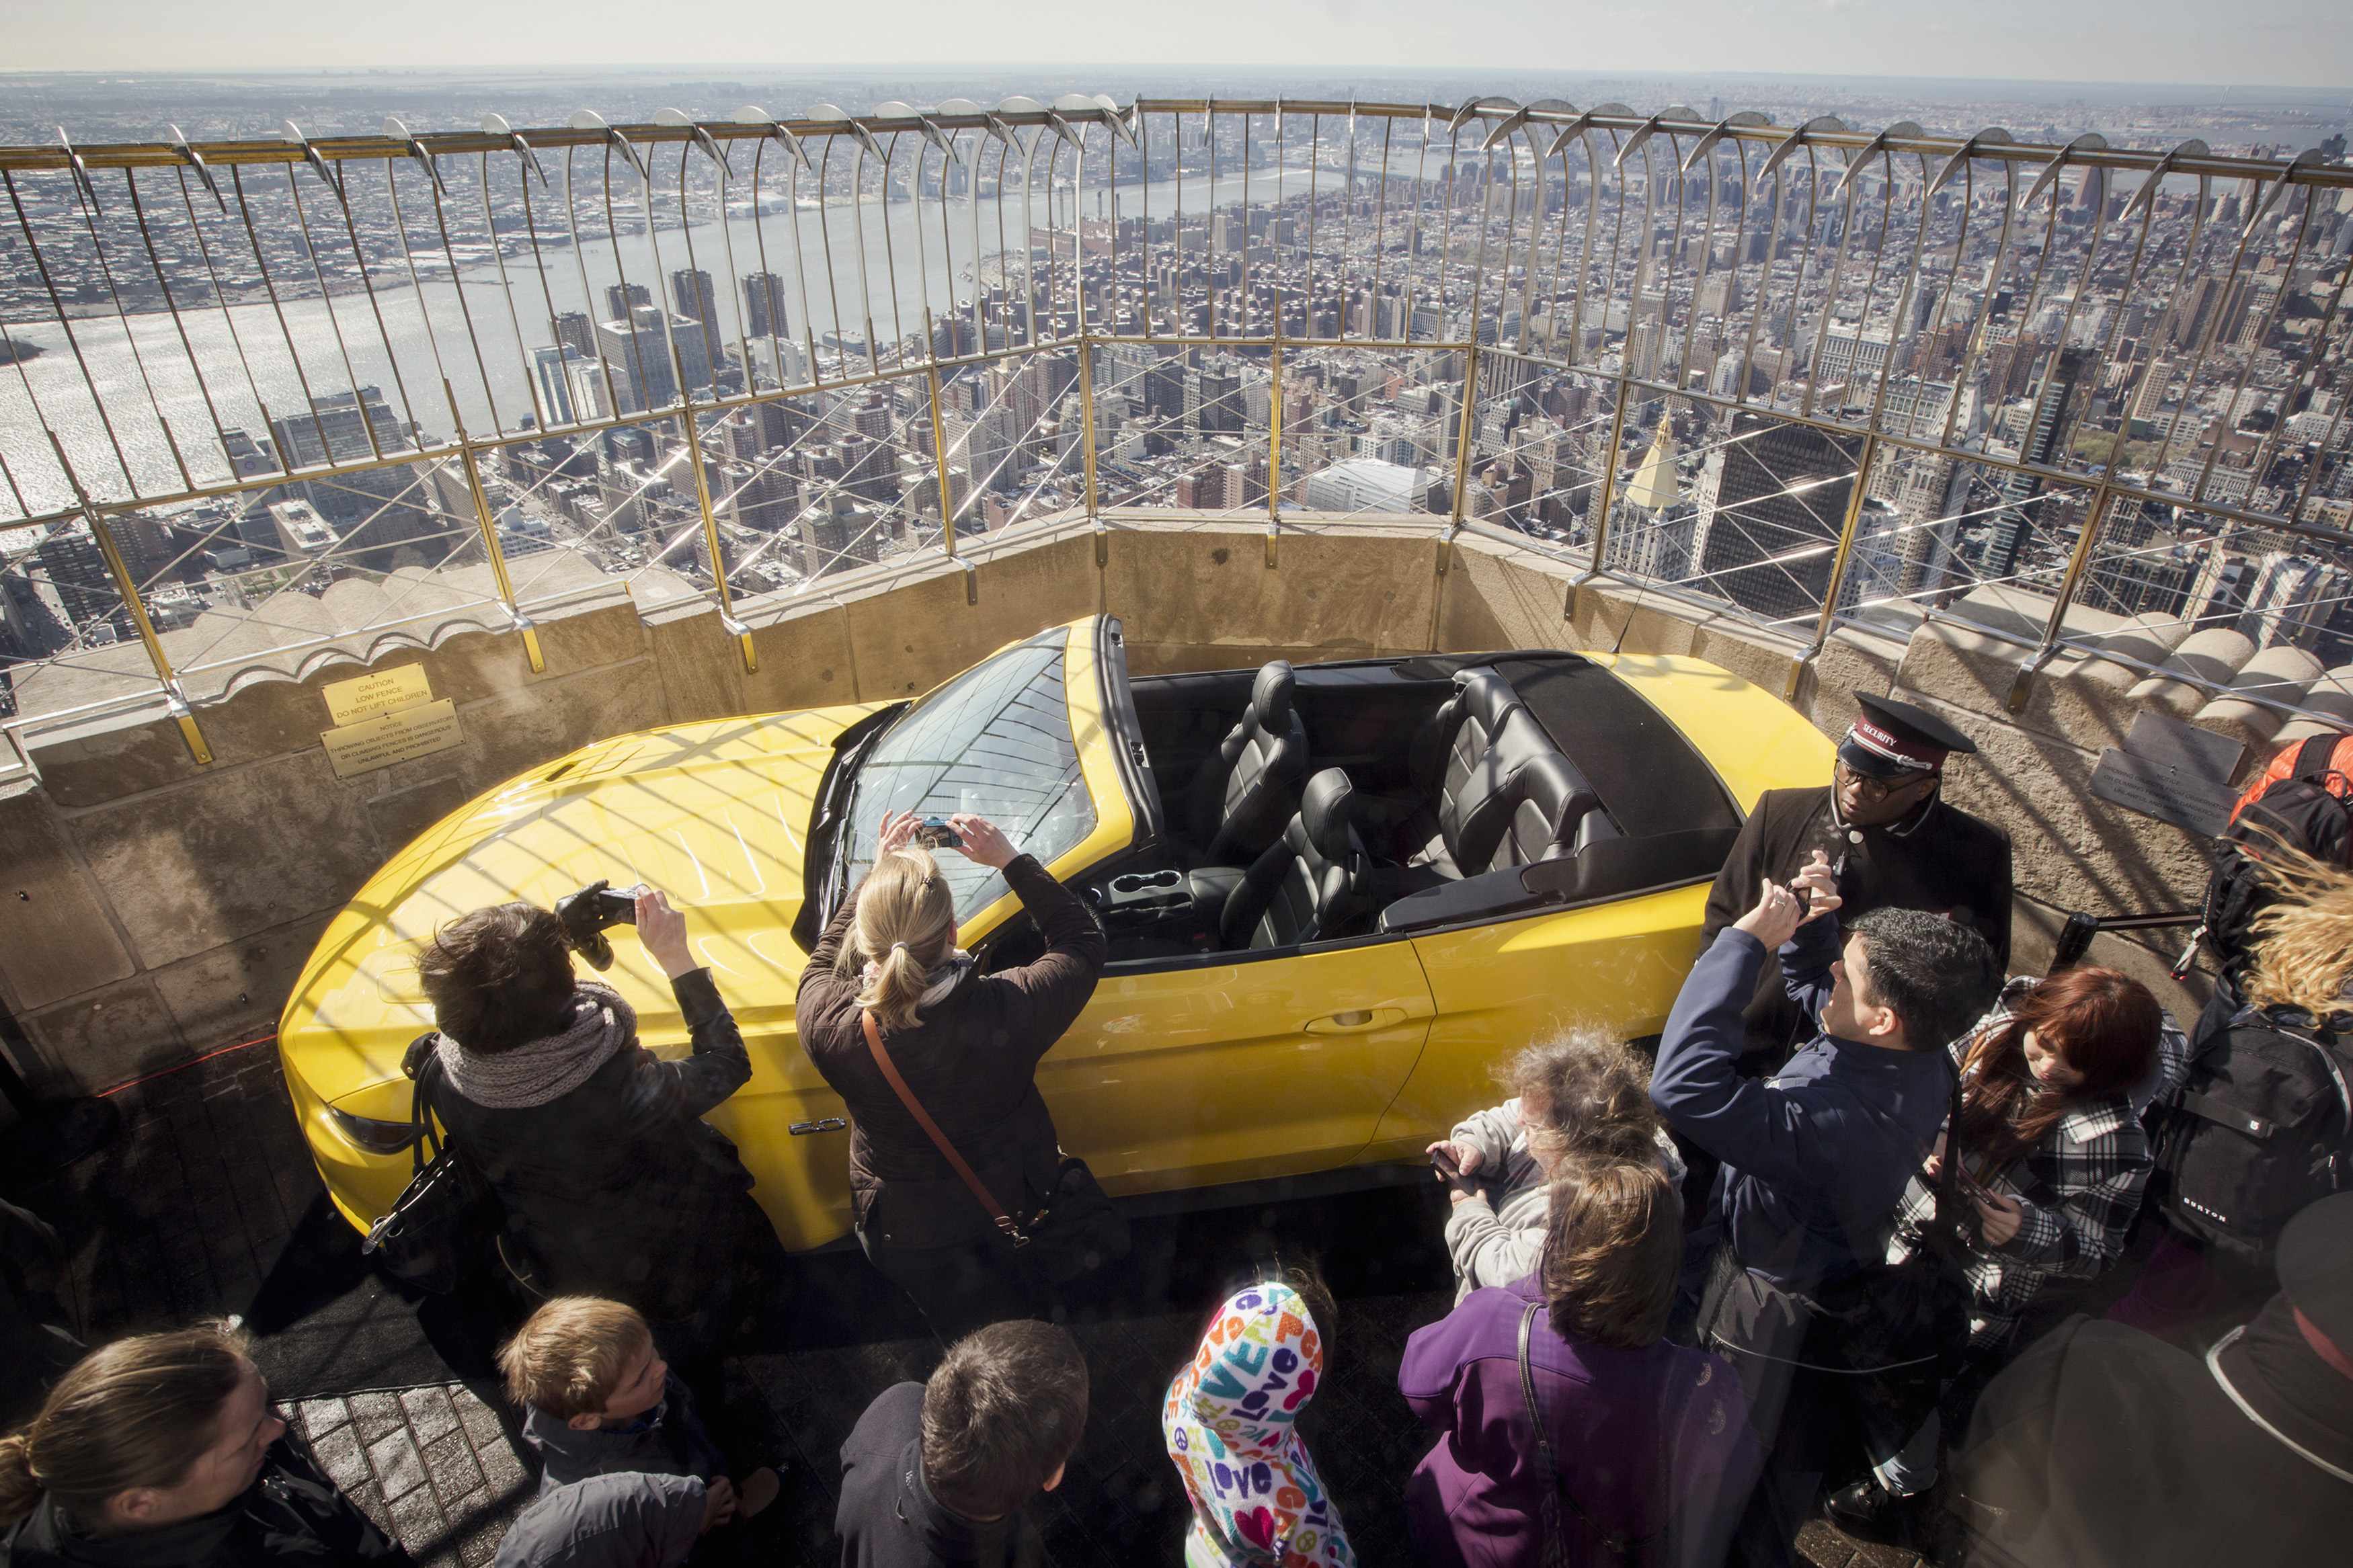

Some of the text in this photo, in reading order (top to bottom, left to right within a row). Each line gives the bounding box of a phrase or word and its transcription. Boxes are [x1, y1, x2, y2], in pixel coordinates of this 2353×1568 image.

[355, 686, 403, 703] LOW FENCE
[357, 677, 394, 692] CAUTION
[335, 689, 428, 718] DO NOT LIFT CHILDREN
[329, 714, 454, 753] THROWING OBJECTS FROM OBSERVATORY
[379, 720, 403, 731] NOTICE
[1862, 723, 1897, 747] SECURITY
[351, 744, 381, 757] CLIMBING
[381, 737, 407, 748] FENCES
[413, 724, 451, 739] DANGEROUS
[357, 751, 391, 764] UNLAWFUL
[405, 736, 441, 750] PROHIBITED
[2184, 1196, 2227, 1222] BURTON
